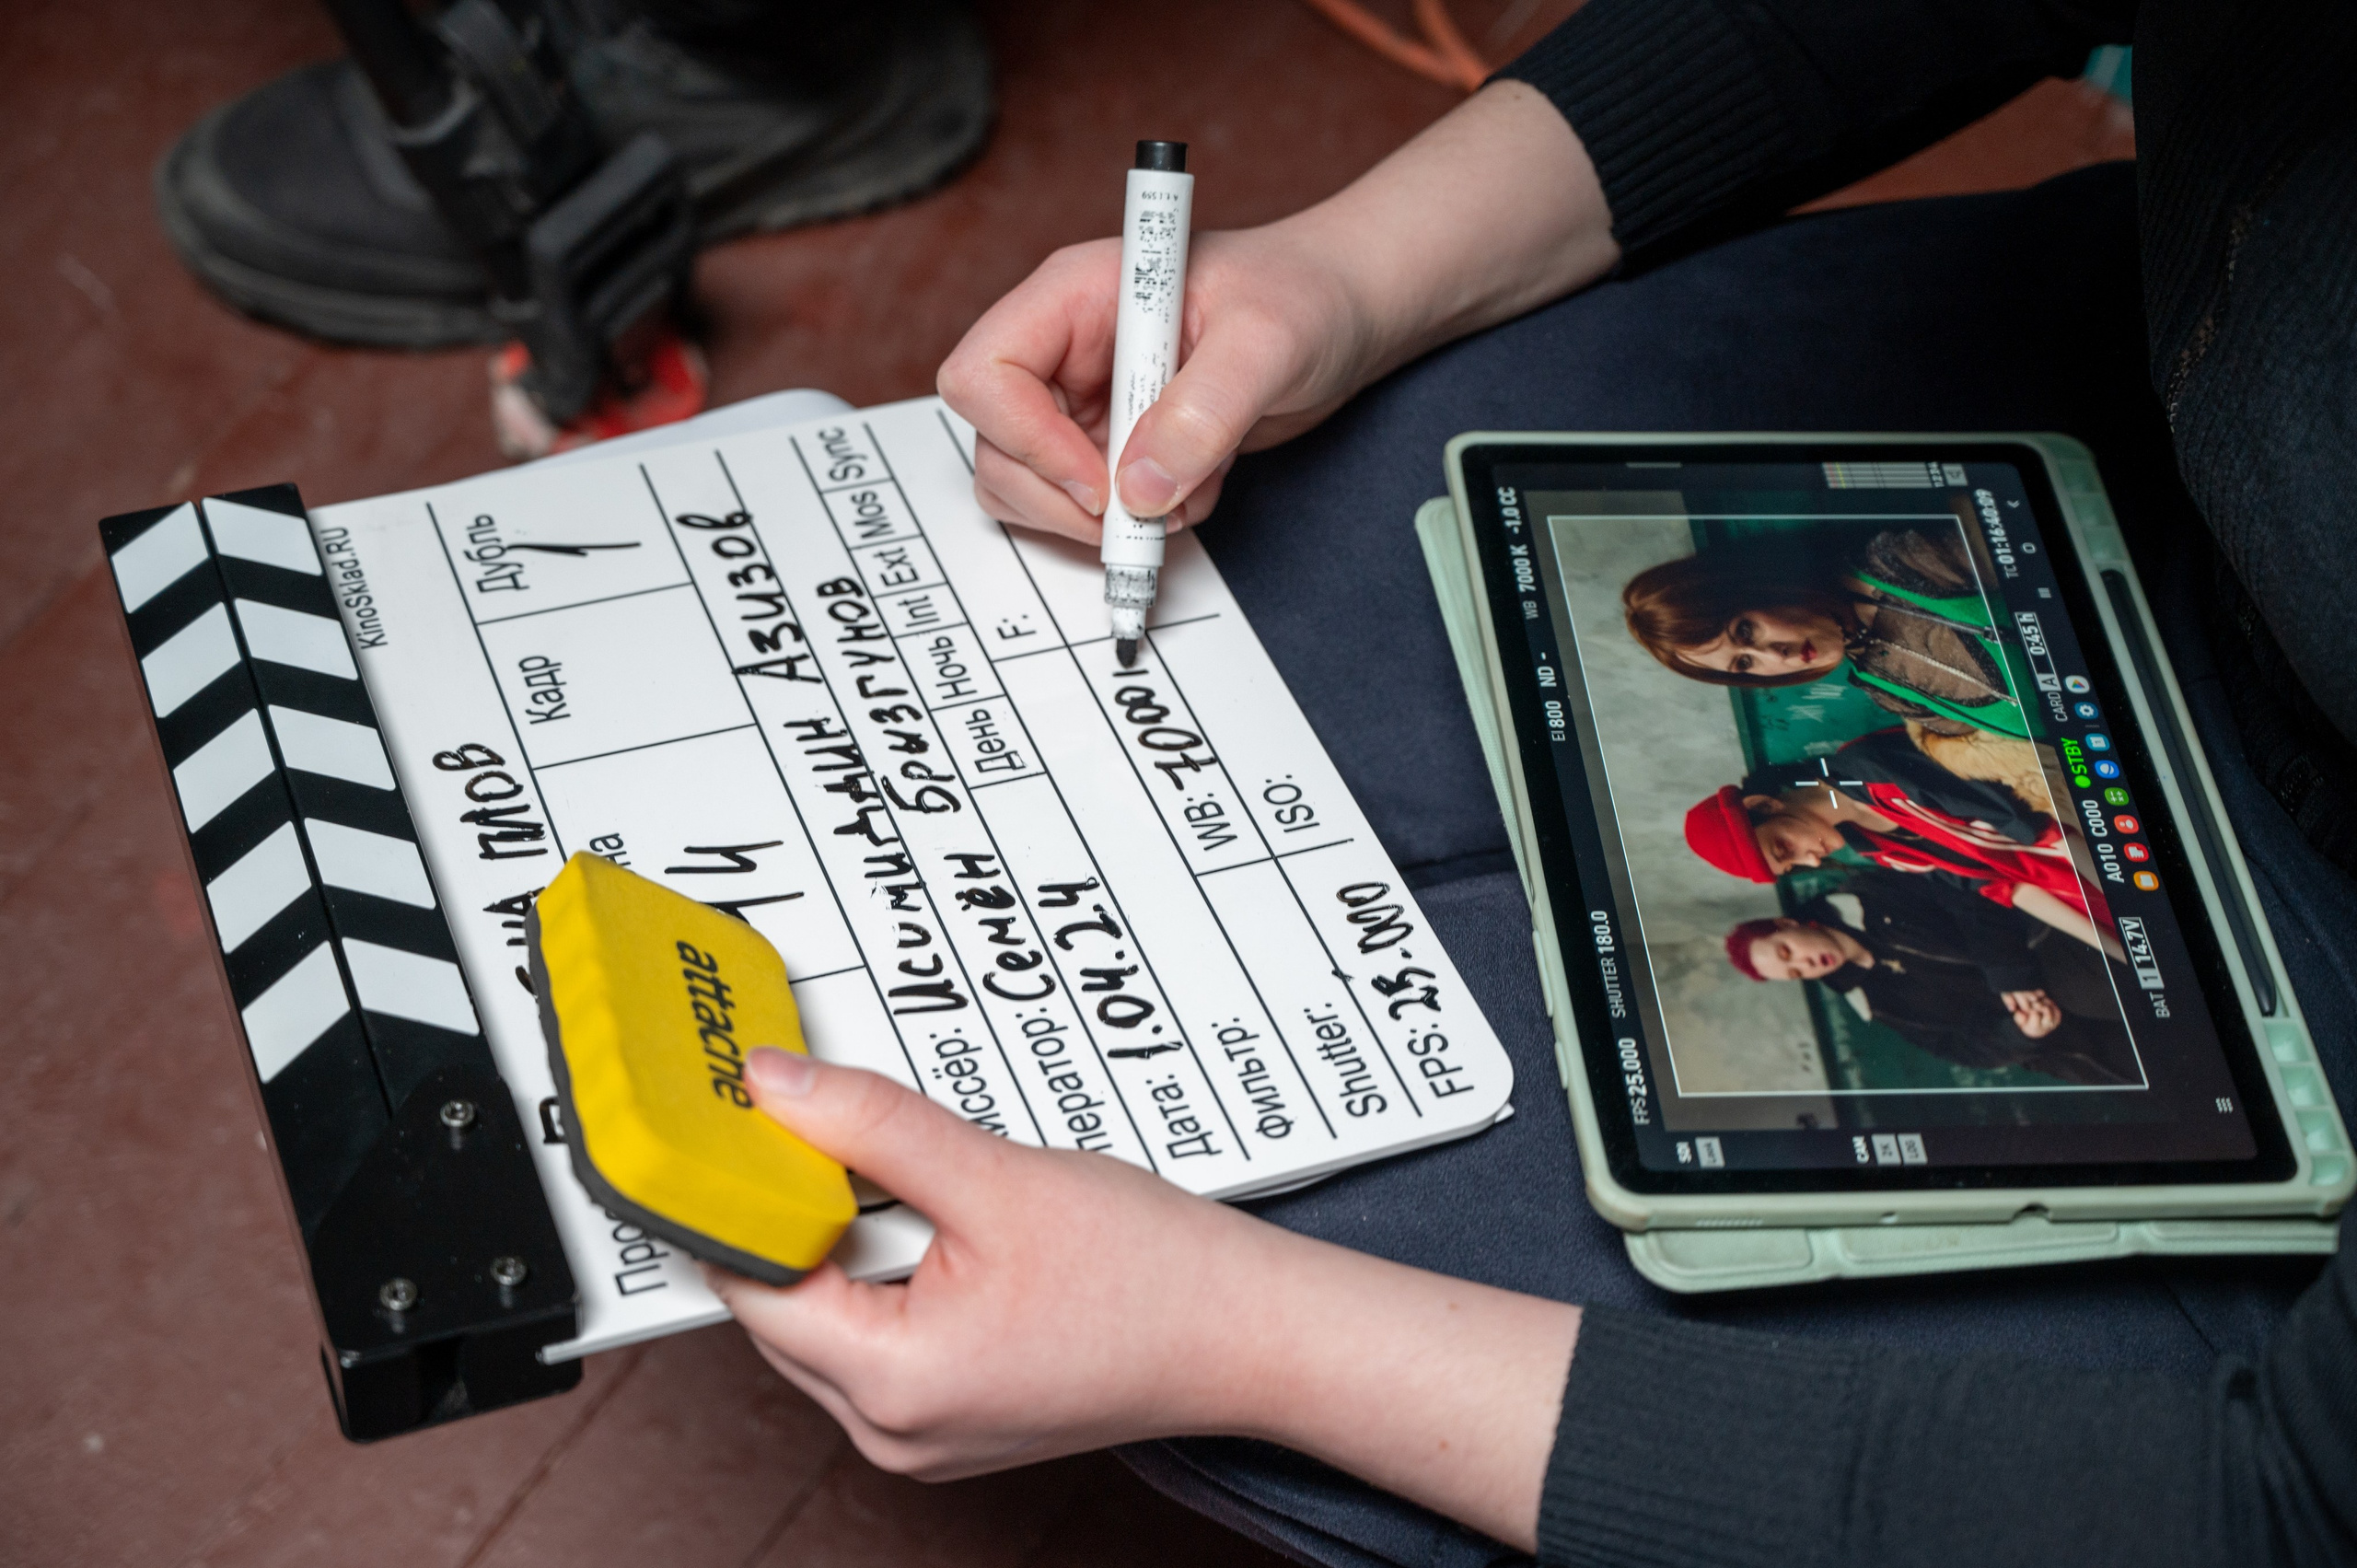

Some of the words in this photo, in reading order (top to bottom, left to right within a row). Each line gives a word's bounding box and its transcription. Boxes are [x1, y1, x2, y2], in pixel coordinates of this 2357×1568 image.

[817, 427, 865, 483] Sync
[850, 491, 897, 540] Mos
[464, 513, 529, 595] Дубль
[873, 547, 920, 588] Ext
[1513, 557, 1537, 592] 7000
[2005, 564, 2020, 579] TC
[320, 527, 389, 650] KinoSklad.RU
[1522, 600, 1538, 620] WB
[897, 592, 943, 635] Int
[995, 613, 1037, 641] F:
[2023, 624, 2046, 656] 0:45
[518, 656, 571, 726] Кадр
[927, 635, 981, 702] Ночь
[1537, 666, 1557, 688] ND
[2041, 676, 2060, 688] A
[1545, 700, 1566, 729] 800
[2047, 691, 2069, 722] CARD
[964, 708, 1028, 774] День
[2061, 737, 2088, 775] STBY
[1184, 794, 1238, 851] WB:
[1263, 775, 1319, 833] ISO:
[2082, 799, 2108, 837] C000
[2097, 843, 2125, 883] A010
[1590, 910, 1616, 954] 180.0
[2121, 918, 2152, 963] 14.7V
[1599, 957, 1627, 1019] SHUTTER
[2149, 991, 2171, 1018] BAT
[675, 940, 757, 1109] attache
[1015, 1007, 1113, 1152] ператор:
[1212, 1016, 1291, 1141] Фильтр:
[1304, 1002, 1387, 1118] Shutter:
[1405, 1026, 1474, 1099] FPS:
[1618, 1037, 1648, 1097] 25.000
[929, 1028, 1009, 1138] иссёр:
[1145, 1072, 1223, 1160] Дата:
[1631, 1098, 1651, 1125] FPS
[1852, 1135, 1870, 1164] CAM
